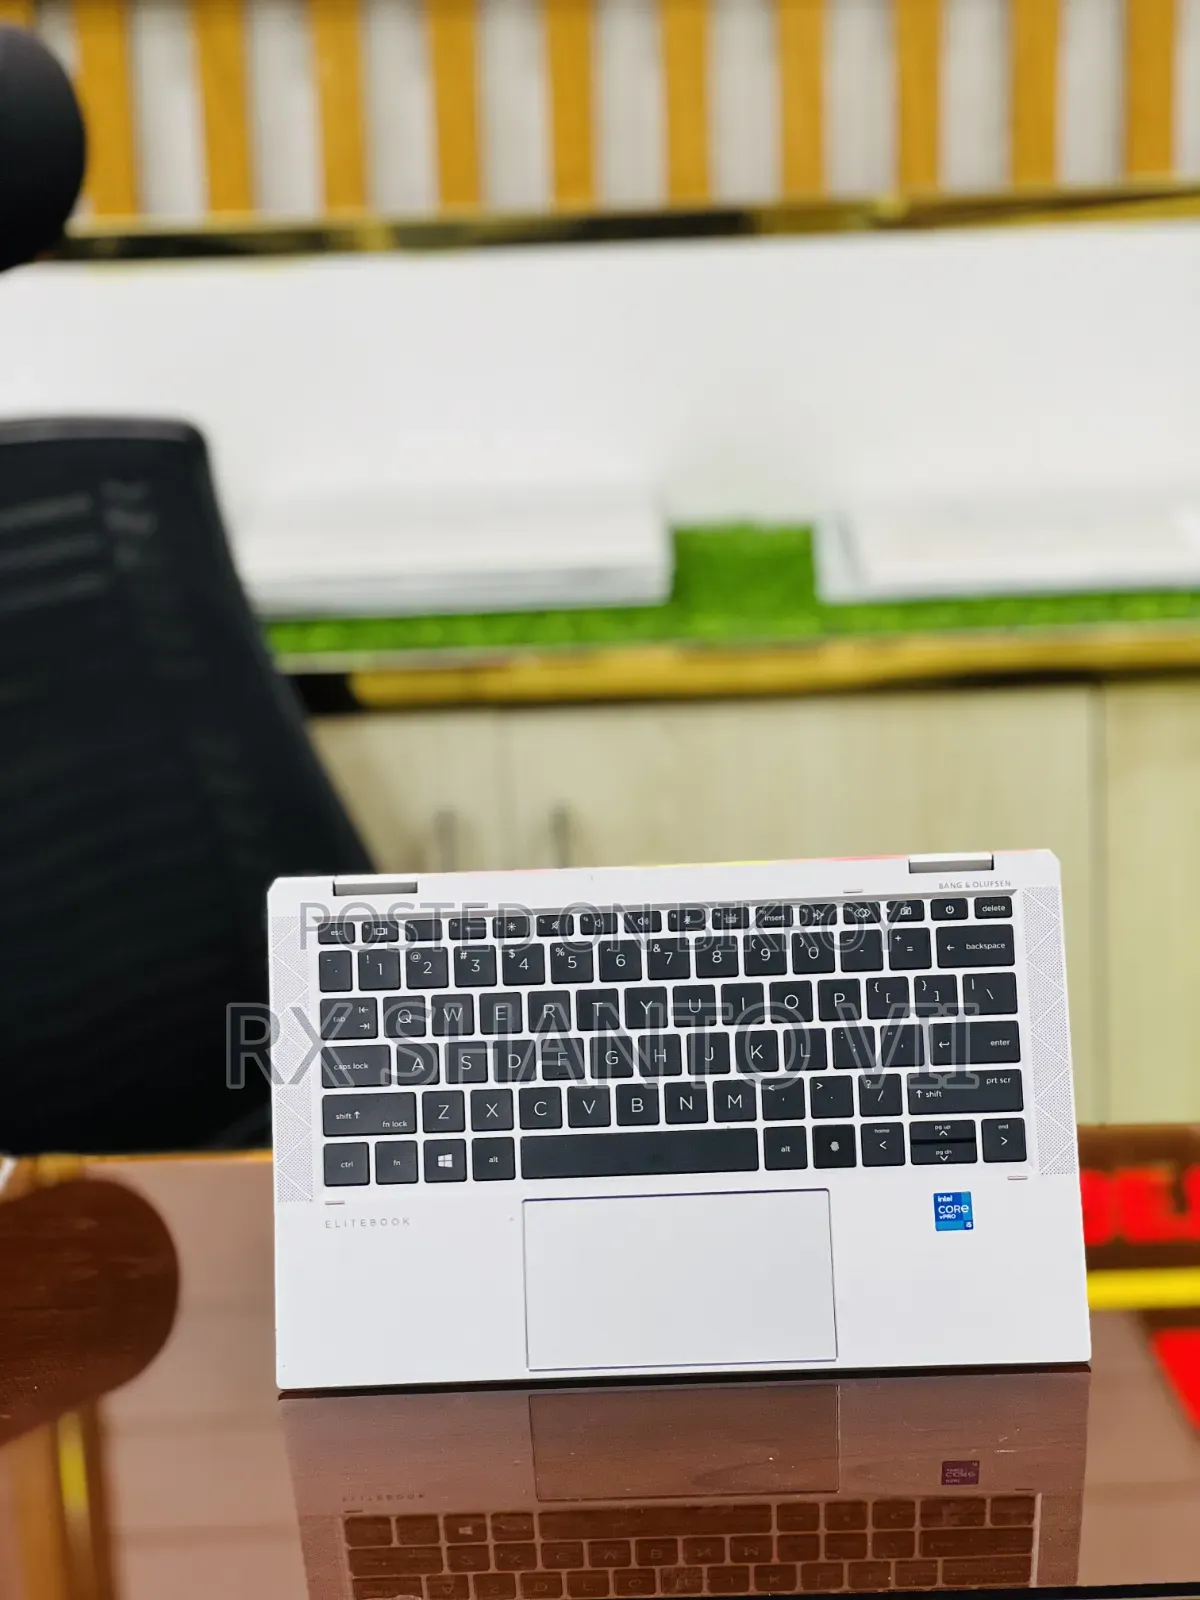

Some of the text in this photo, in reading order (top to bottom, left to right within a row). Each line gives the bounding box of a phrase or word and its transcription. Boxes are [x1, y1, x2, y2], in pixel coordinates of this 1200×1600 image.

[938, 881, 963, 890] BANG
[972, 880, 1012, 888] OLUFSEN
[764, 914, 785, 922] insert
[555, 947, 565, 957] %
[653, 944, 661, 953] &
[966, 942, 1006, 951] backspace
[410, 952, 421, 962] @
[460, 951, 468, 959] #
[508, 949, 516, 959] $
[616, 954, 626, 967] 6
[664, 952, 673, 965] 7
[712, 950, 722, 963] 8
[761, 948, 771, 962] 9
[377, 963, 383, 975] 1
[423, 961, 432, 974] 2
[471, 959, 481, 973] 3
[519, 958, 529, 970] 4
[567, 956, 577, 969] 5
[688, 999, 702, 1013] U
[784, 995, 799, 1009] O
[834, 993, 846, 1007] P
[443, 1007, 463, 1022] W
[495, 1006, 507, 1021] E
[543, 1004, 555, 1018] R
[592, 1002, 603, 1017] T
[640, 1000, 653, 1015] Y
[398, 1009, 412, 1024] Q
[654, 1048, 667, 1063] H
[705, 1047, 714, 1062] J
[751, 1044, 764, 1059] K
[800, 1043, 810, 1057] L
[411, 1057, 425, 1072] A
[461, 1056, 472, 1070] S
[508, 1054, 521, 1069] D
[557, 1052, 568, 1067] F
[605, 1051, 619, 1065] G
[352, 1062, 369, 1070] lock
[986, 1077, 998, 1085] prt
[926, 1090, 942, 1098] shift
[534, 1101, 547, 1116] C
[582, 1100, 596, 1114] V
[631, 1098, 644, 1113] B
[680, 1096, 693, 1111] N
[728, 1094, 743, 1109] M
[335, 1112, 352, 1120] shift
[438, 1105, 450, 1120] Z
[486, 1103, 498, 1118] X
[938, 1195, 953, 1203] intel
[325, 1217, 410, 1228] ELITEBOOK
